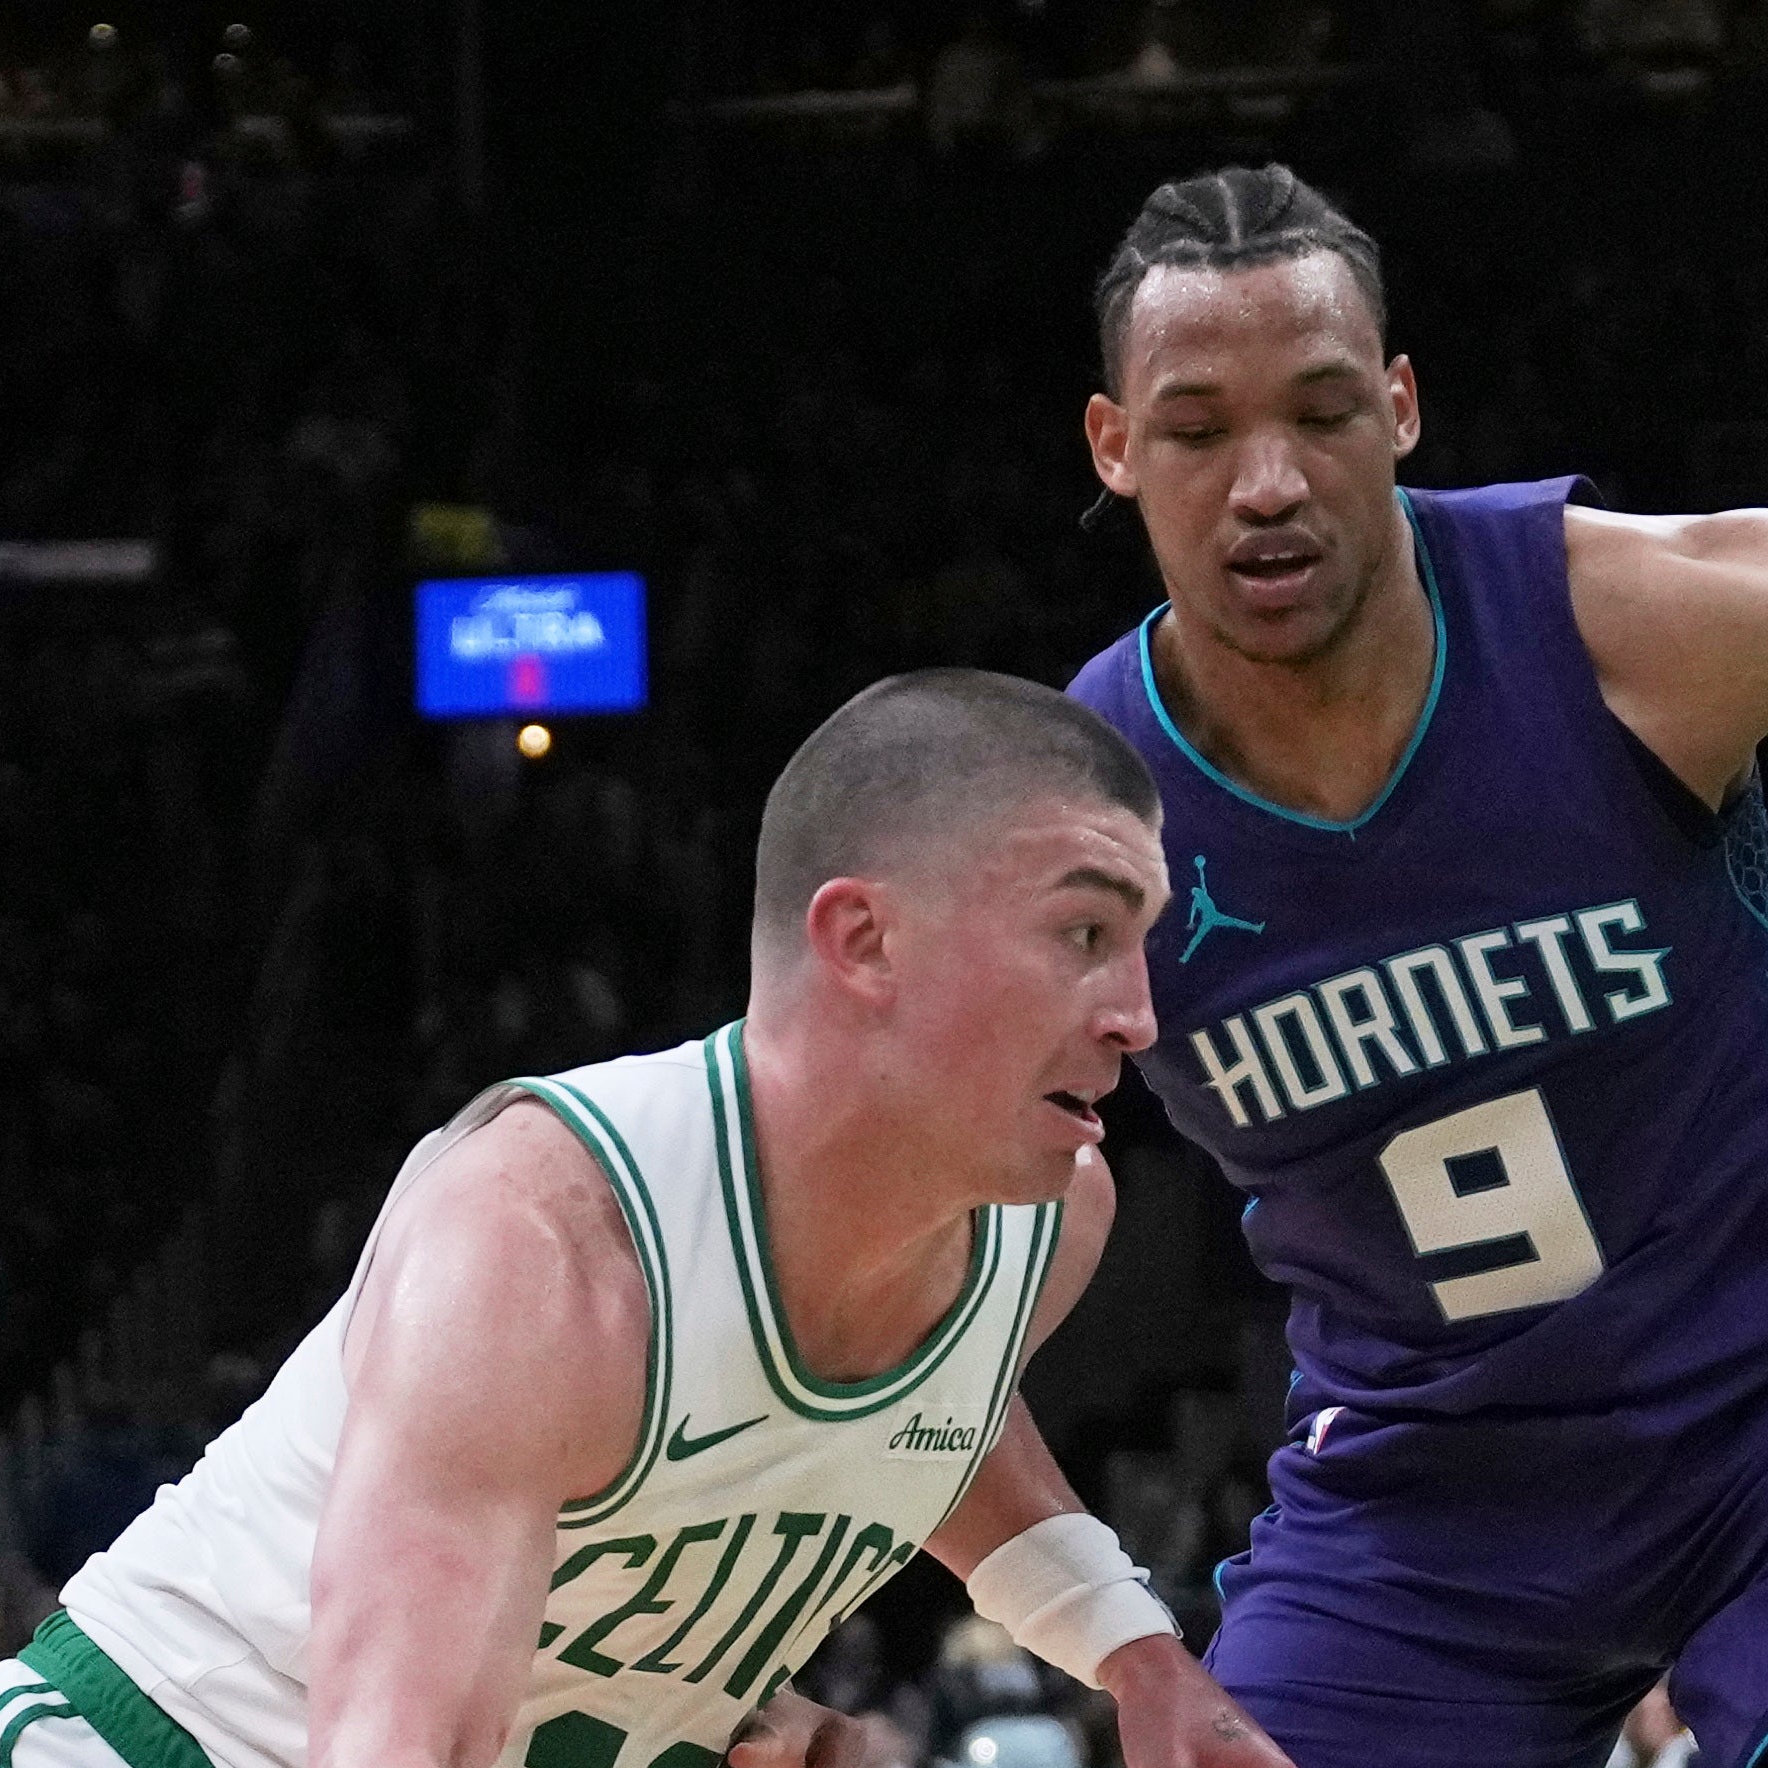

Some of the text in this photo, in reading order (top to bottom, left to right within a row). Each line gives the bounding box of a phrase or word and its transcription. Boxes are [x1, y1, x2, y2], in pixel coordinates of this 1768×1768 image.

[1190, 898, 1673, 1128] HORNETS
[1378, 1085, 1605, 1325] 9
[888, 1411, 976, 1452] Amica
